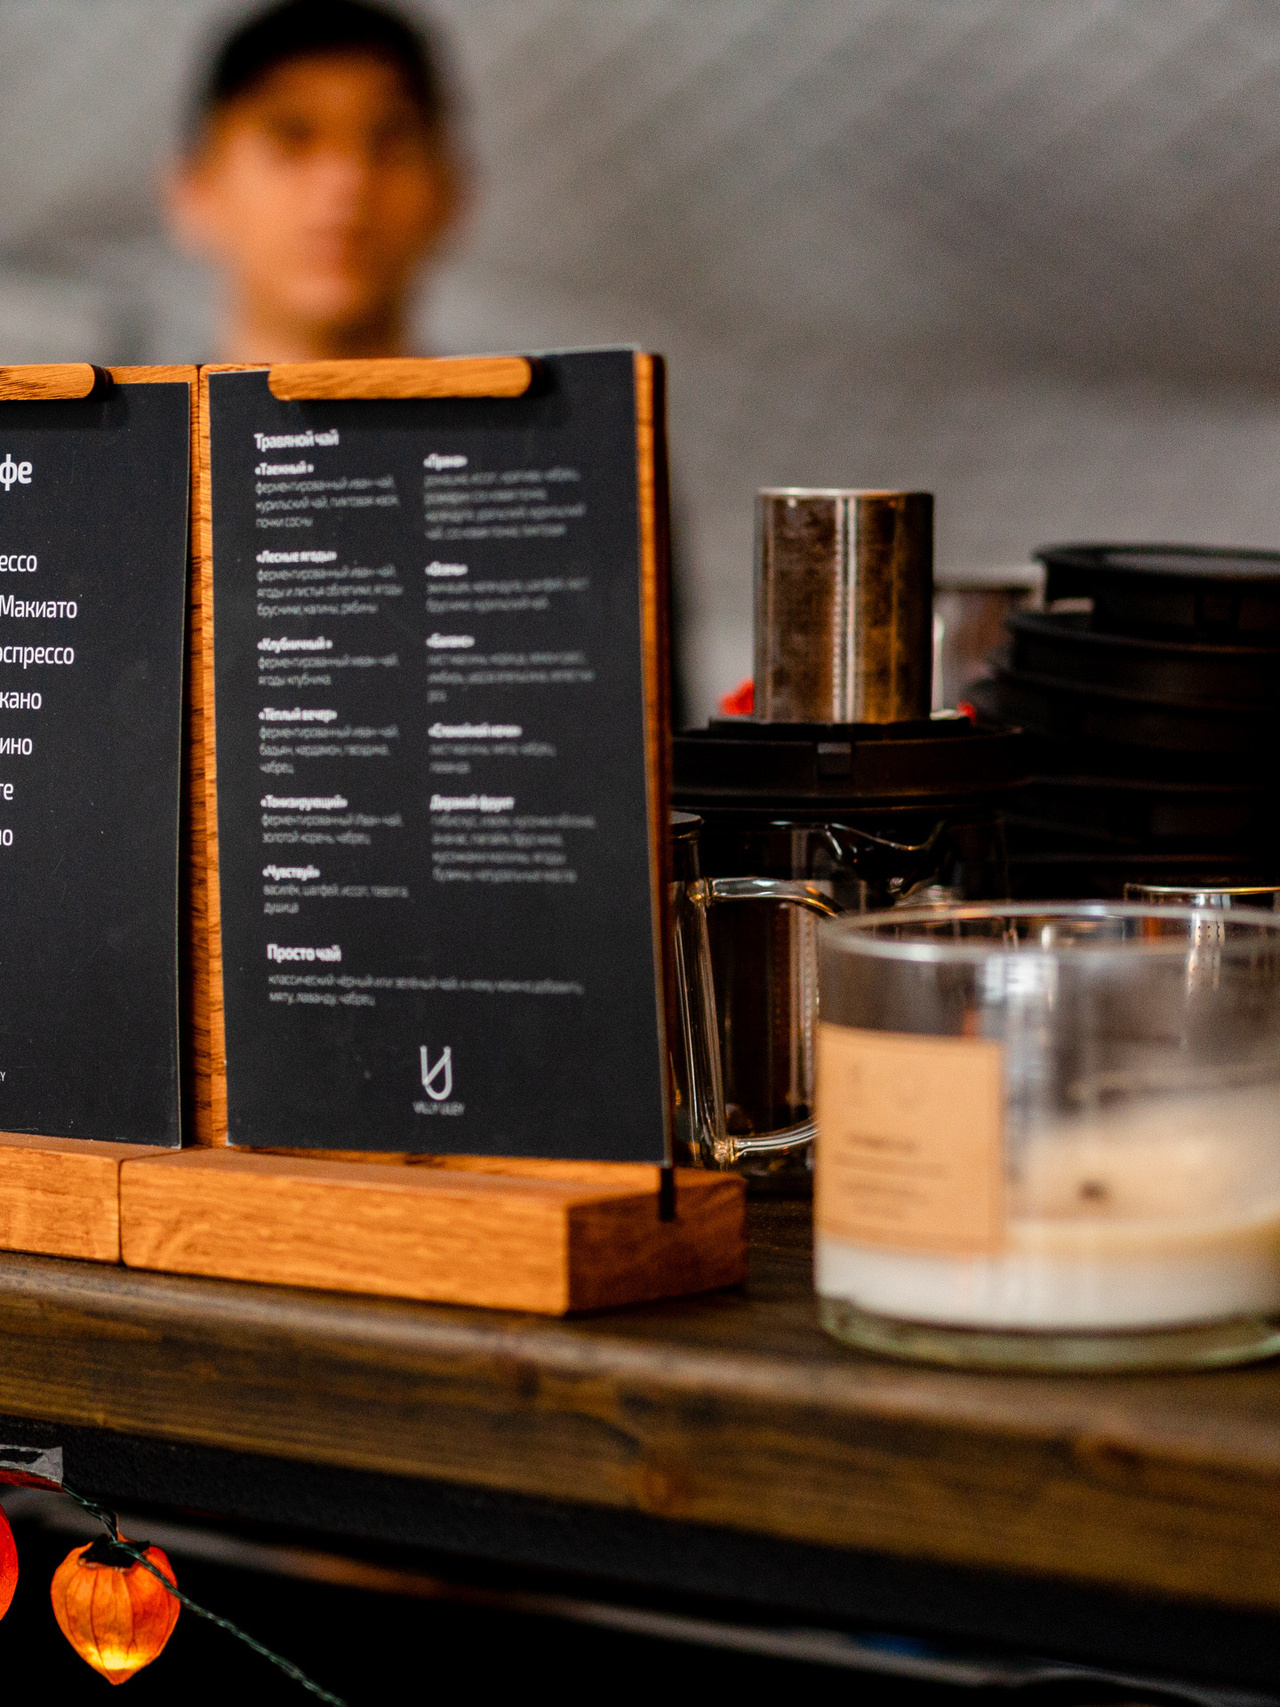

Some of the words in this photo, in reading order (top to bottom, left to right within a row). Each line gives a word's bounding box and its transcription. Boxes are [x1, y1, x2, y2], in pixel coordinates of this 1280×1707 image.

[254, 430, 314, 452] Травяной
[315, 428, 340, 446] чай
[267, 943, 315, 963] Просто
[316, 944, 342, 962] чай
